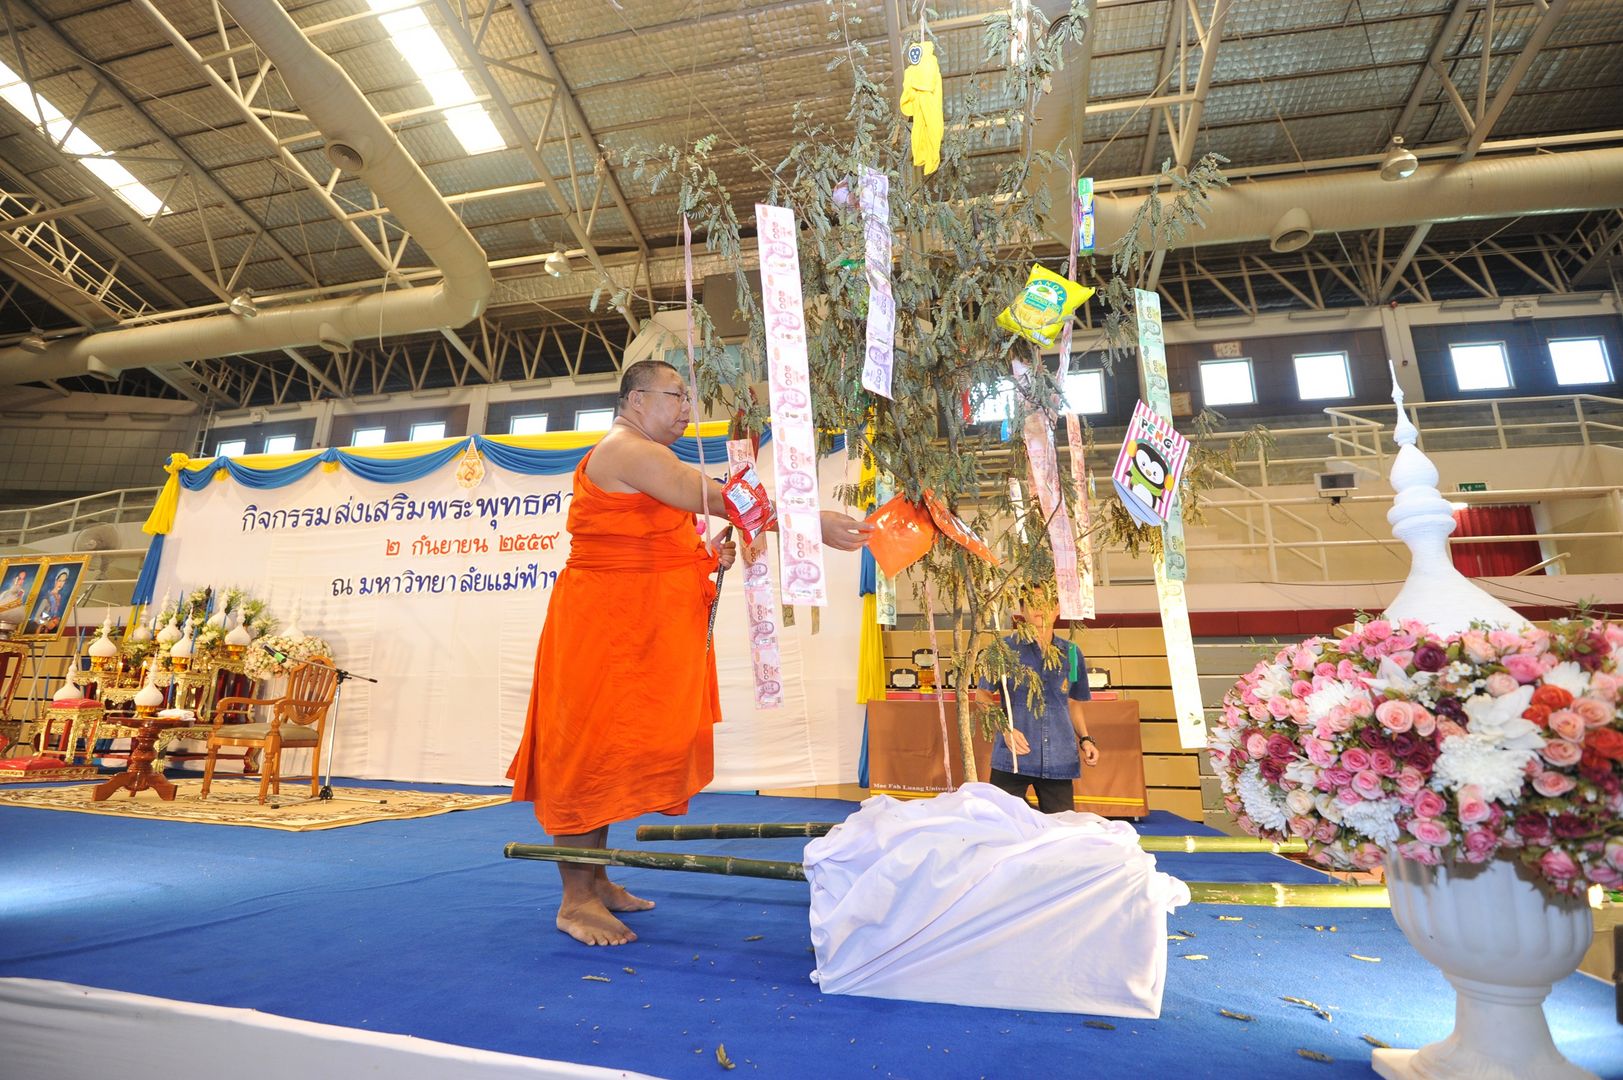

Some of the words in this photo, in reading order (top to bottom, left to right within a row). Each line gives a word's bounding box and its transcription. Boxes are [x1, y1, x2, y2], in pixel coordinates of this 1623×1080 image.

[1141, 418, 1179, 455] PENGY
[386, 539, 401, 556] ๒
[412, 534, 489, 556] กันยายน
[499, 532, 560, 552] ๒๕๕๙
